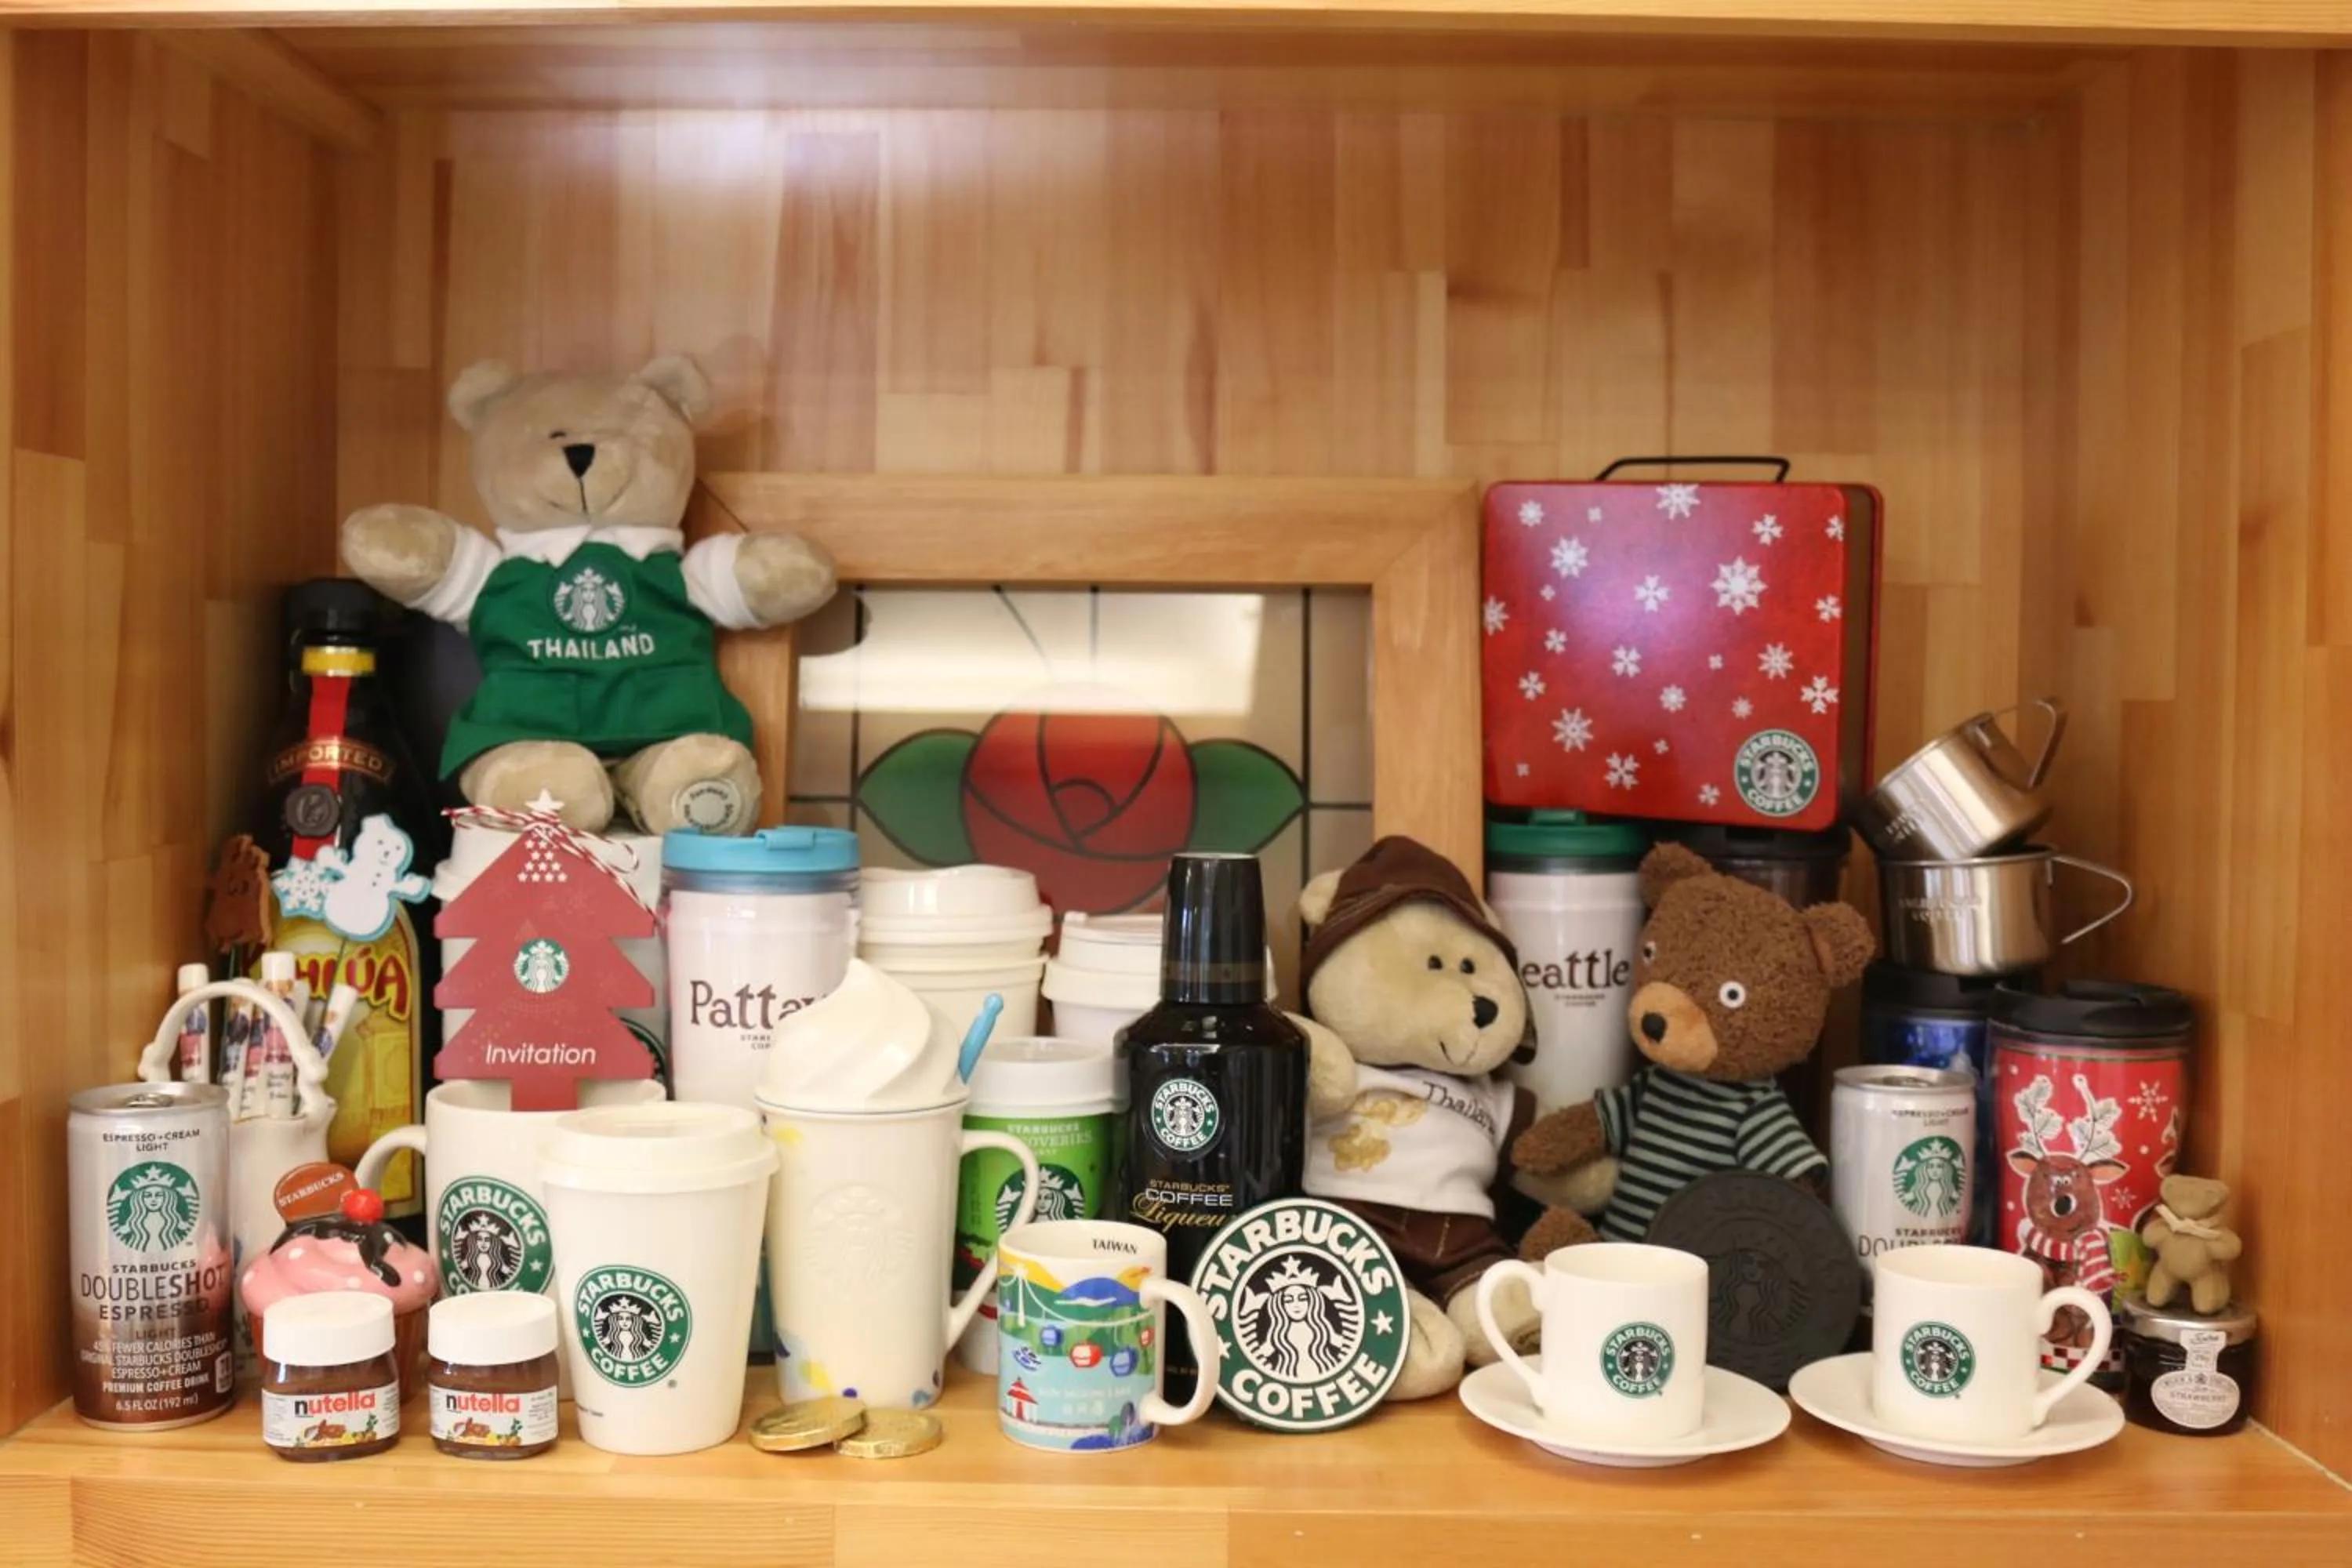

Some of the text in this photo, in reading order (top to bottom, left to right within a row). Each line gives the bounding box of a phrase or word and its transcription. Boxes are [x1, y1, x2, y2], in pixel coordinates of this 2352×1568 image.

[527, 633, 655, 659] THAILAND
[274, 742, 383, 775] IMPORTED
[1740, 734, 1813, 771] STARBUCKS
[1747, 788, 1802, 812] COFFEE
[1521, 948, 1631, 989] eattle
[485, 1042, 597, 1065] Invitation
[1155, 1082, 1214, 1113] STARBUCKS
[136, 1142, 169, 1152] LIGHT
[1160, 1127, 1207, 1148] COFFEE
[278, 1171, 345, 1207] STARBUCKS
[1145, 1187, 1233, 1207] COFFEE
[1150, 1178, 1225, 1192] STARBUCKS
[439, 1185, 546, 1247] STARBUCKS
[1092, 1238, 1138, 1254] TAIWAN
[112, 1258, 196, 1274] STARBUCKS
[1204, 1210, 1393, 1321] STARBUCKS
[81, 1264, 227, 1301] DOUBLESHOT
[100, 1298, 209, 1321] ESPRESSO
[578, 1272, 684, 1323] STARBUCKS
[112, 1341, 145, 1354] FEWER
[146, 1335, 193, 1353] CALORIES
[136, 1327, 176, 1340] LIGHT
[1606, 1327, 1671, 1356] STARBUCKS
[1904, 1327, 1970, 1360] STARBUCKS
[114, 1352, 173, 1367] STARBUCKS
[590, 1346, 670, 1381] COFFEE
[103, 1373, 210, 1393] PREMIUM COFFEE DRINK
[1231, 1352, 1388, 1419] COFFEE
[1612, 1374, 1661, 1393] COFFEE
[1910, 1370, 1960, 1393] COFFEE
[294, 1391, 376, 1416] nutella
[445, 1392, 521, 1414] nutella
